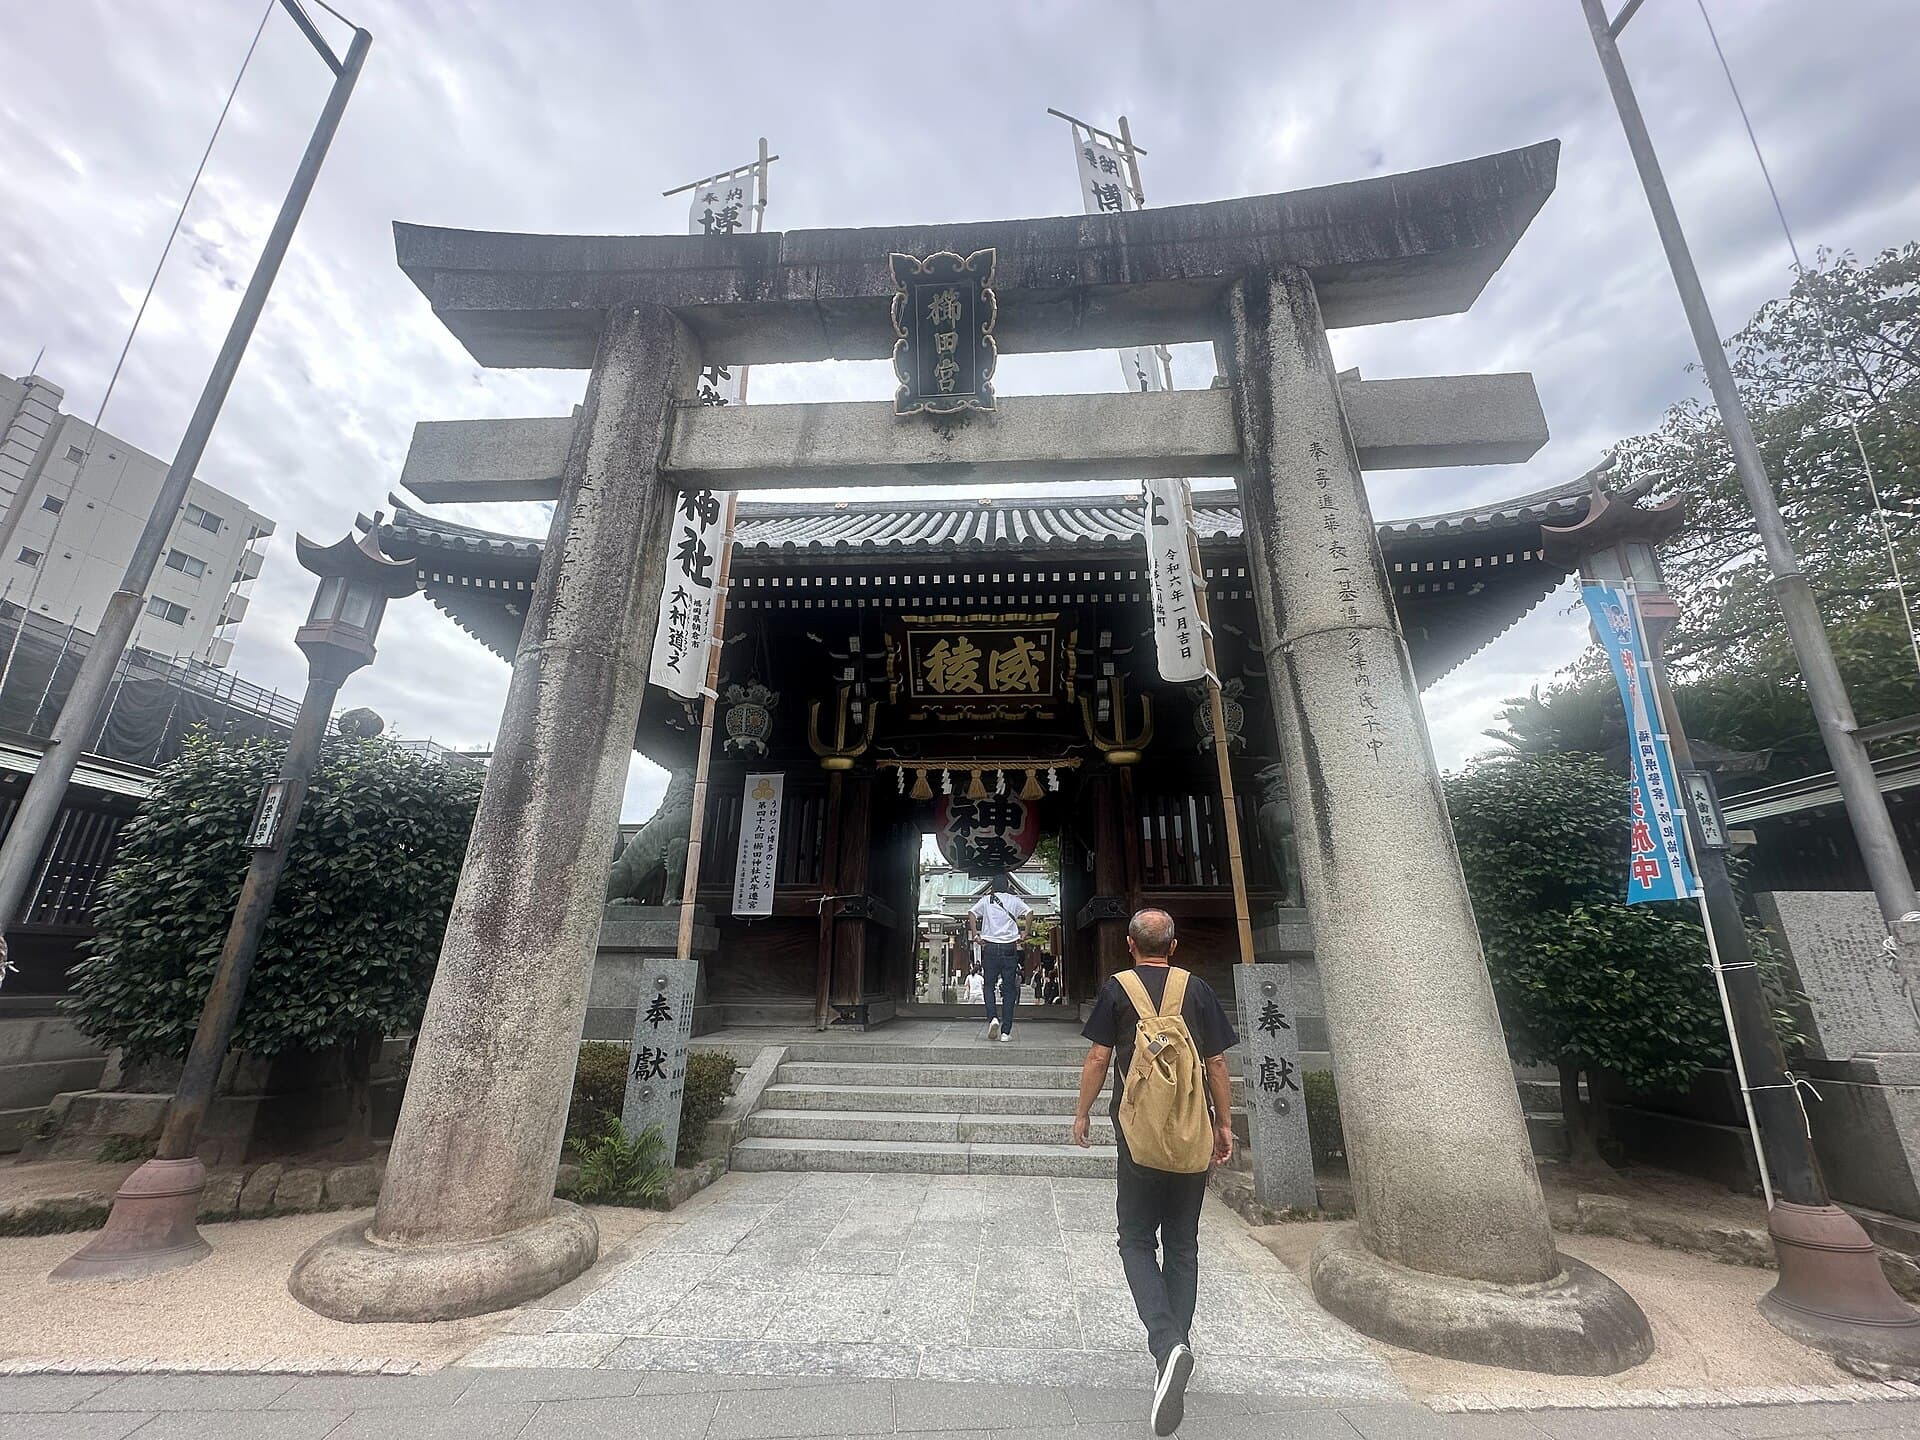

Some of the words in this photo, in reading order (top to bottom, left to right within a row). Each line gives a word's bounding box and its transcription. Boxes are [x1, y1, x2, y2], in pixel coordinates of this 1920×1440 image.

[926, 290, 962, 393] 櫛田宮
[1165, 549, 1192, 658] 令和六年一月吉日
[754, 801, 767, 840] 第四十九回
[763, 800, 778, 889] うけつぐ博多のこころ
